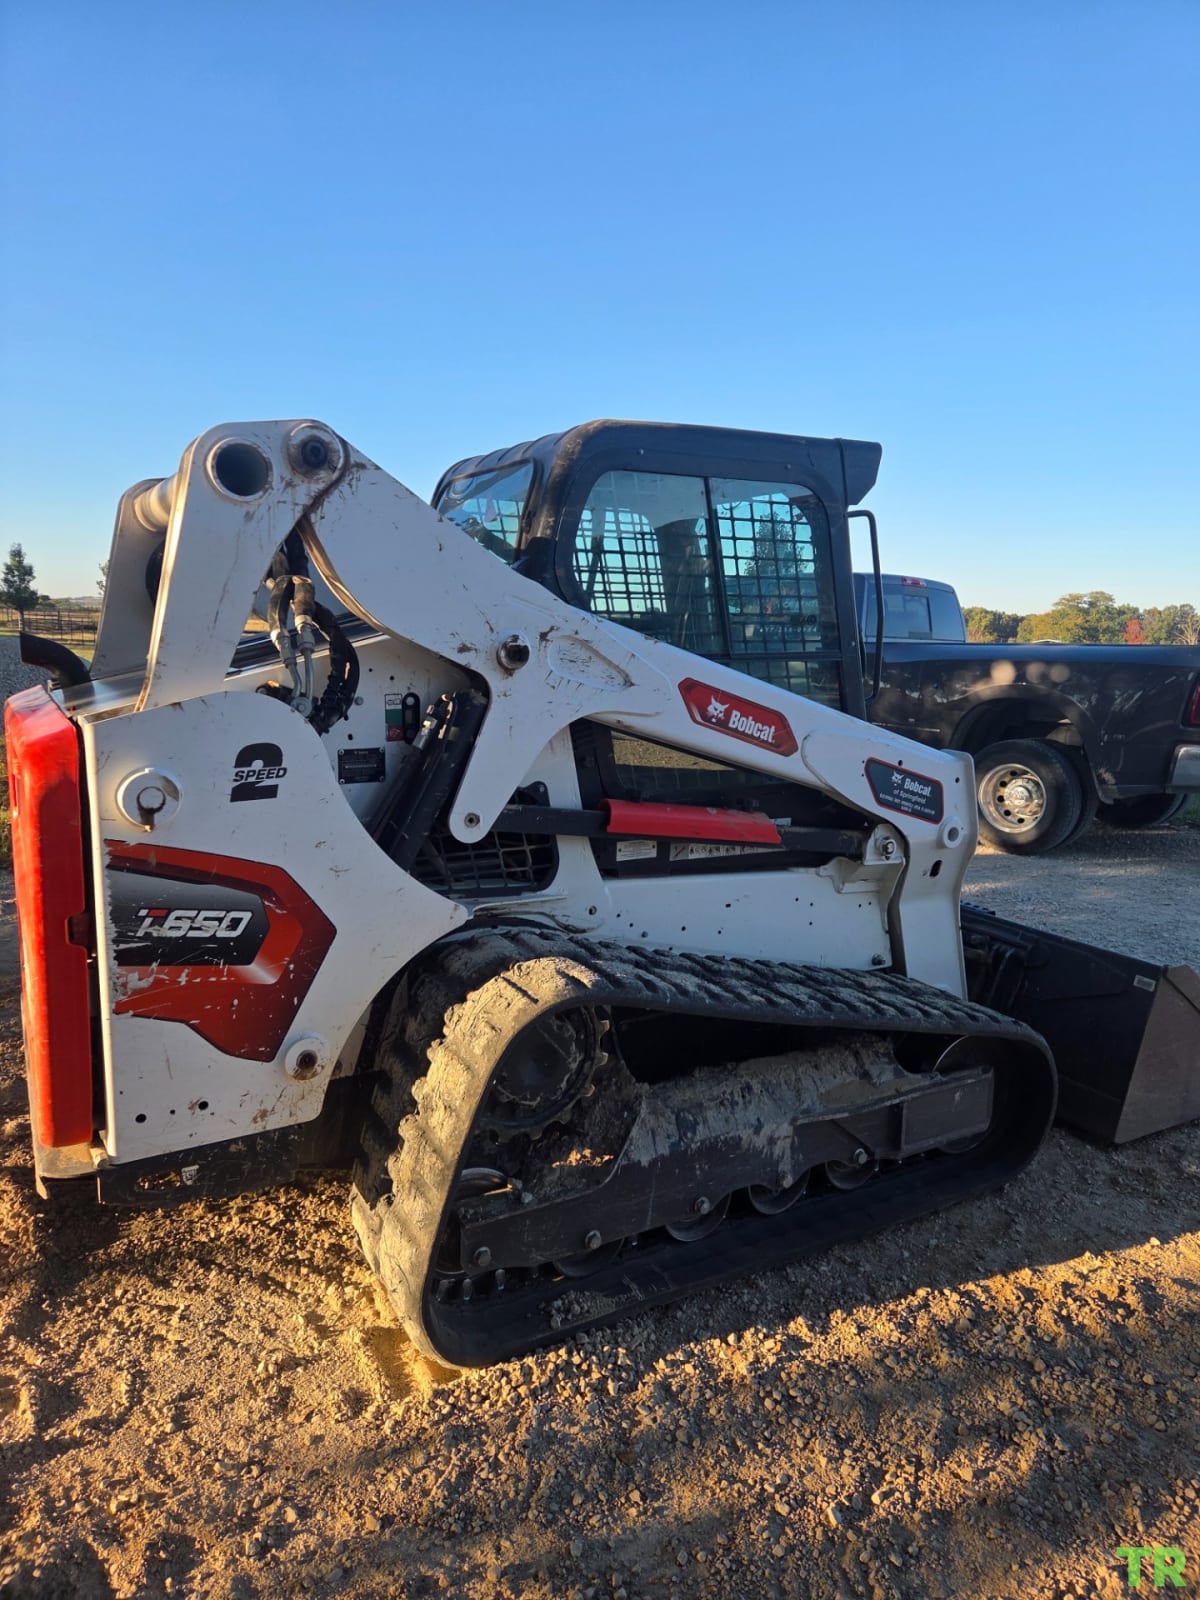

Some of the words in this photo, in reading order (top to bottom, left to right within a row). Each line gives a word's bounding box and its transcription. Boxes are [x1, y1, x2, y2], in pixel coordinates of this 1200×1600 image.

[728, 710, 775, 743] Bobcat
[230, 742, 283, 803] 2
[232, 766, 288, 783] SPEED
[904, 778, 932, 797] Bobcat
[135, 908, 253, 938] T650
